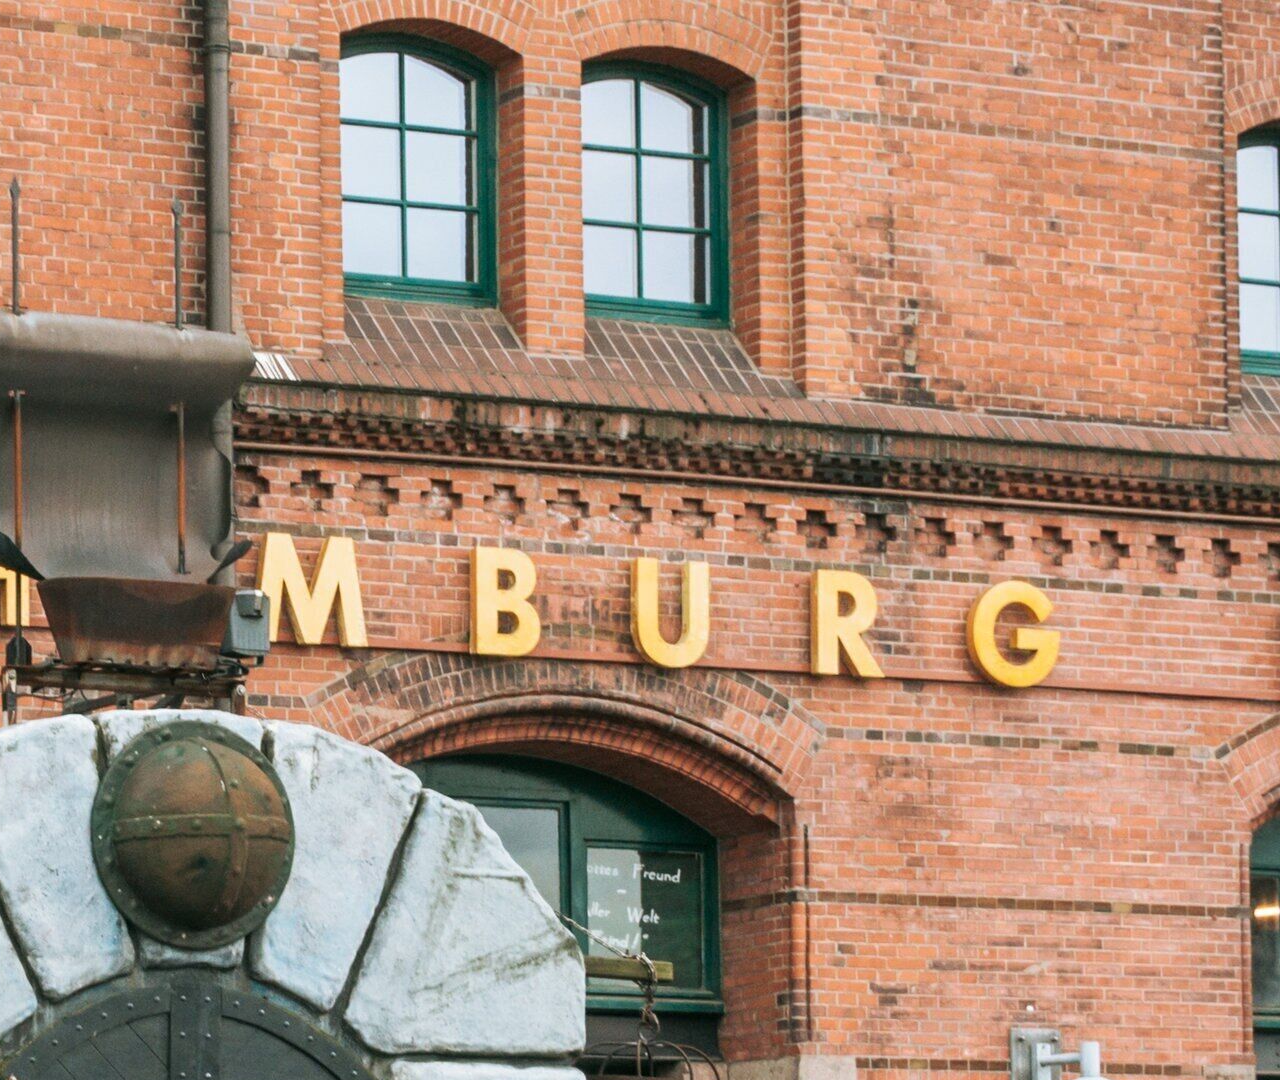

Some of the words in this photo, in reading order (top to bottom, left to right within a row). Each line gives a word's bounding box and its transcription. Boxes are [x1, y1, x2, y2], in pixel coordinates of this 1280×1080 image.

[587, 864, 619, 877] ottes
[632, 863, 682, 883] Freund
[627, 906, 660, 924] Welt
